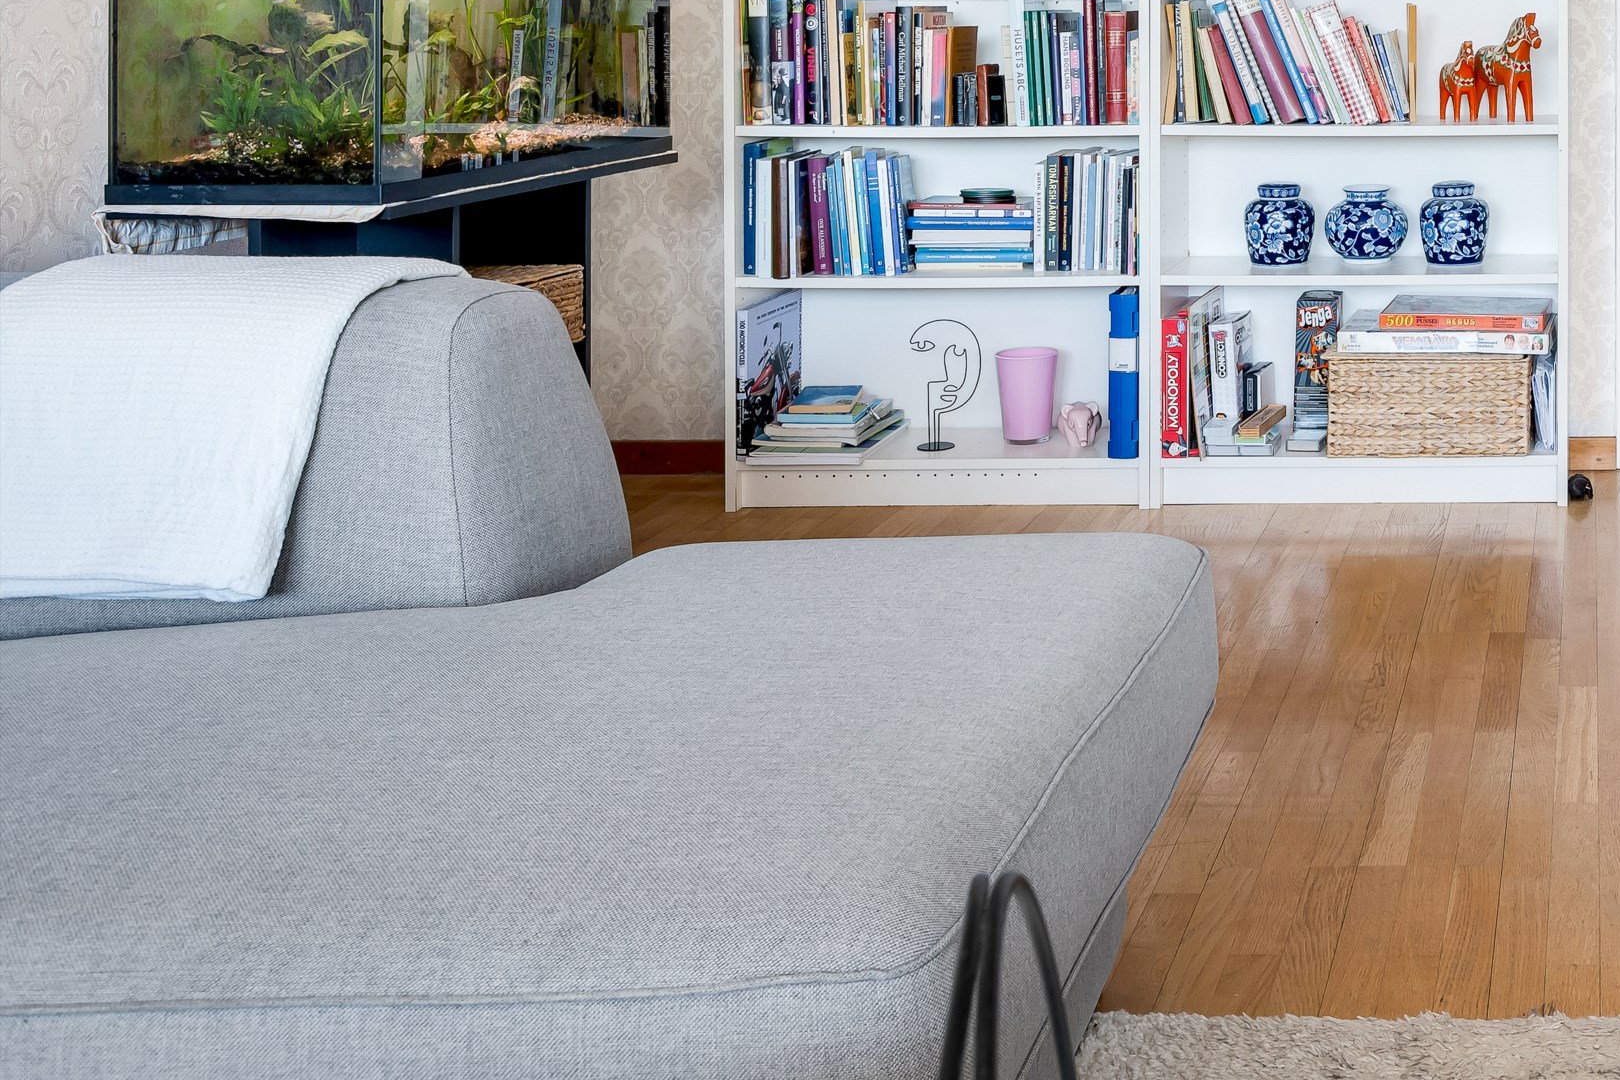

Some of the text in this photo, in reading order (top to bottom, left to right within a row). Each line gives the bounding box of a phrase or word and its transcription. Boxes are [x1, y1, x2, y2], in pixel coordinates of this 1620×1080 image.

[807, 47, 816, 83] VINER
[1014, 29, 1024, 69] HUSETS
[1062, 36, 1070, 56] HANS
[1223, 28, 1253, 89] KOKBOKEN
[898, 32, 906, 102] Carl Michael Bellman
[1017, 71, 1026, 92] ABC
[1048, 163, 1060, 232] TONÅRSHJÄRNAN
[1299, 305, 1333, 328] Jenga
[1385, 315, 1414, 327] 500
[1445, 318, 1476, 326] REBUS
[1213, 331, 1227, 378] CONNECT 4
[1167, 354, 1179, 428] MONOPOLY
